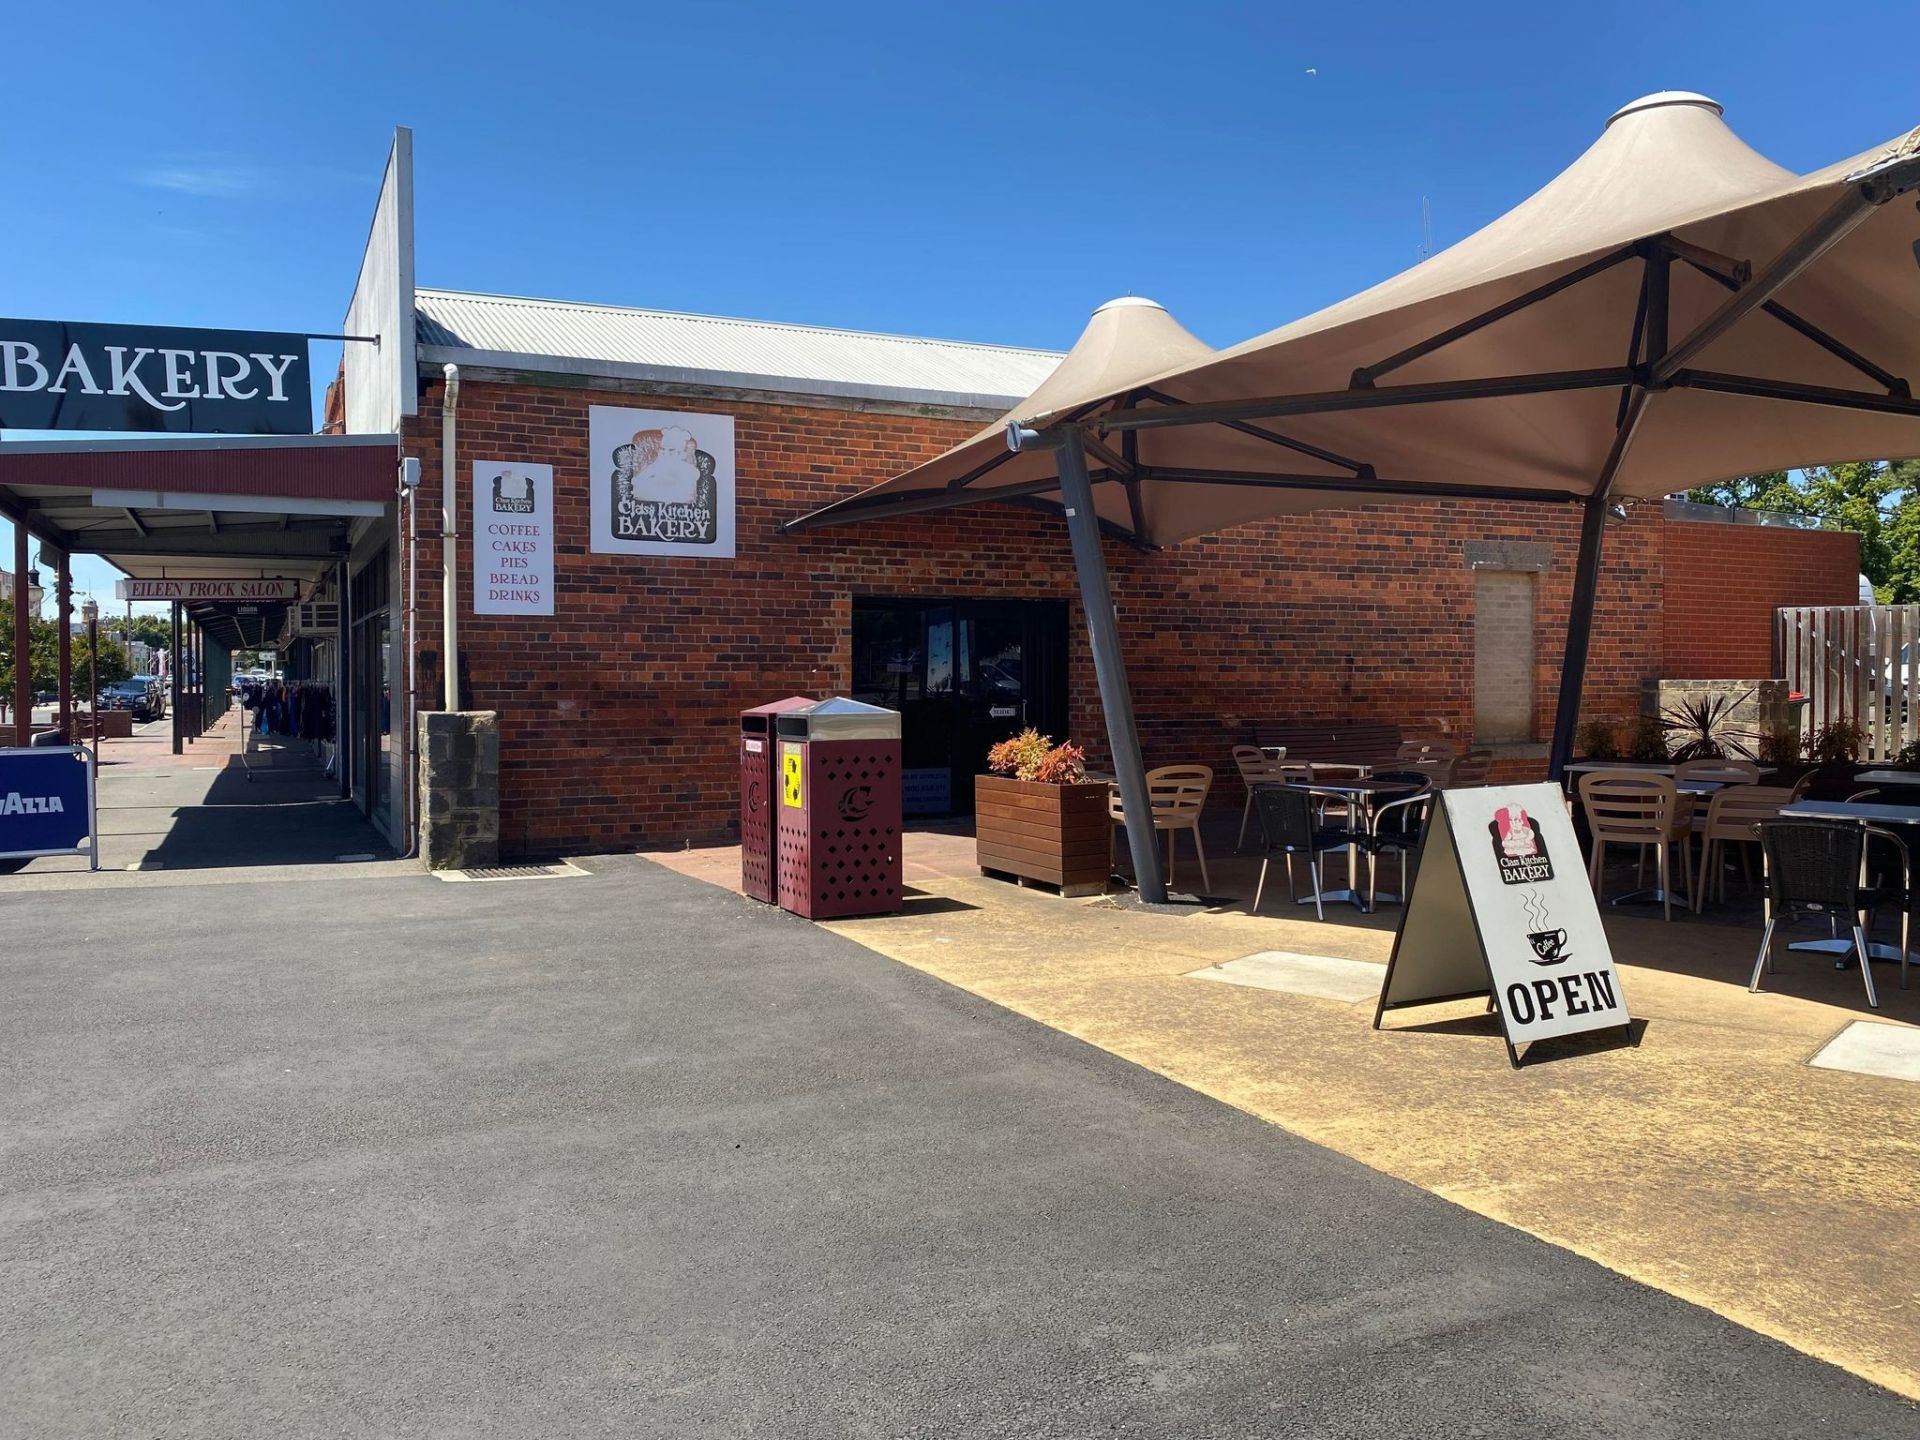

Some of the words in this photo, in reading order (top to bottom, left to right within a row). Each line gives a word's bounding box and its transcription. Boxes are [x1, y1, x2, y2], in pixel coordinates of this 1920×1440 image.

[0, 341, 299, 411] BAKERY
[495, 503, 533, 514] BAKERY
[618, 499, 656, 519] Class
[658, 501, 711, 520] Kitchen
[488, 524, 540, 537] COFFEE
[618, 516, 711, 542] BAKERY
[492, 541, 537, 553] CAKES
[501, 557, 528, 569] PIES
[490, 573, 539, 585] BREAD
[132, 582, 184, 597] EILEEN
[189, 582, 235, 597] FROCK
[240, 582, 285, 597] SALON
[489, 589, 540, 603] DRINKS
[1500, 857, 1519, 868] Class
[1519, 854, 1548, 867] Kitchen
[1503, 864, 1550, 883] BAKERY
[1536, 938, 1556, 956] Coffee
[1506, 970, 1617, 1025] OPEN
